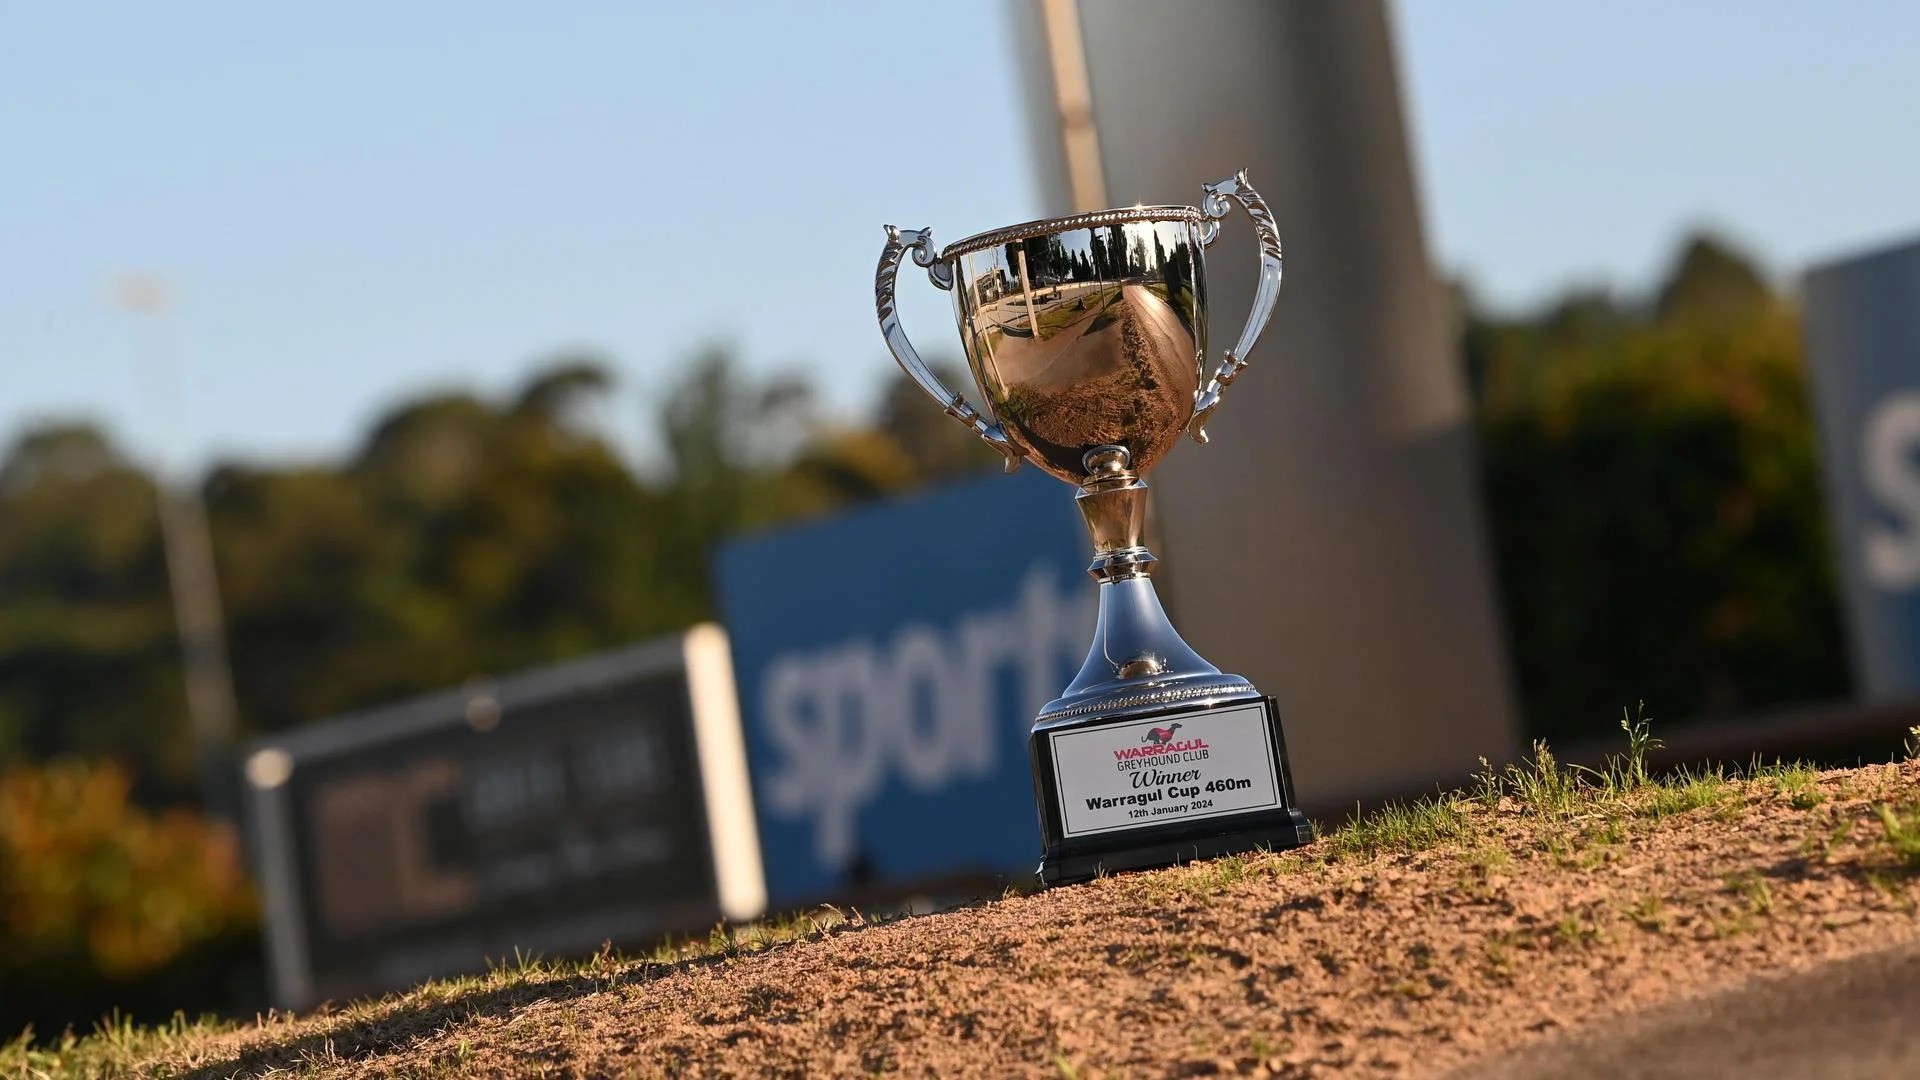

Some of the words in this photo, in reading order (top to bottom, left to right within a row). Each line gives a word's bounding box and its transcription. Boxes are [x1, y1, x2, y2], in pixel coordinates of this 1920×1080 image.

[1113, 738, 1209, 761] WARRAGUL
[1117, 755, 1181, 772] GREYHOUND
[1183, 750, 1209, 762] CLUB
[1129, 768, 1201, 788] Winner
[1086, 789, 1163, 811] Warragul
[1167, 785, 1200, 800] Cup
[1205, 778, 1252, 793] 460m
[1128, 808, 1149, 819] 12th
[1151, 803, 1188, 818] January
[1191, 799, 1213, 811] 2024
